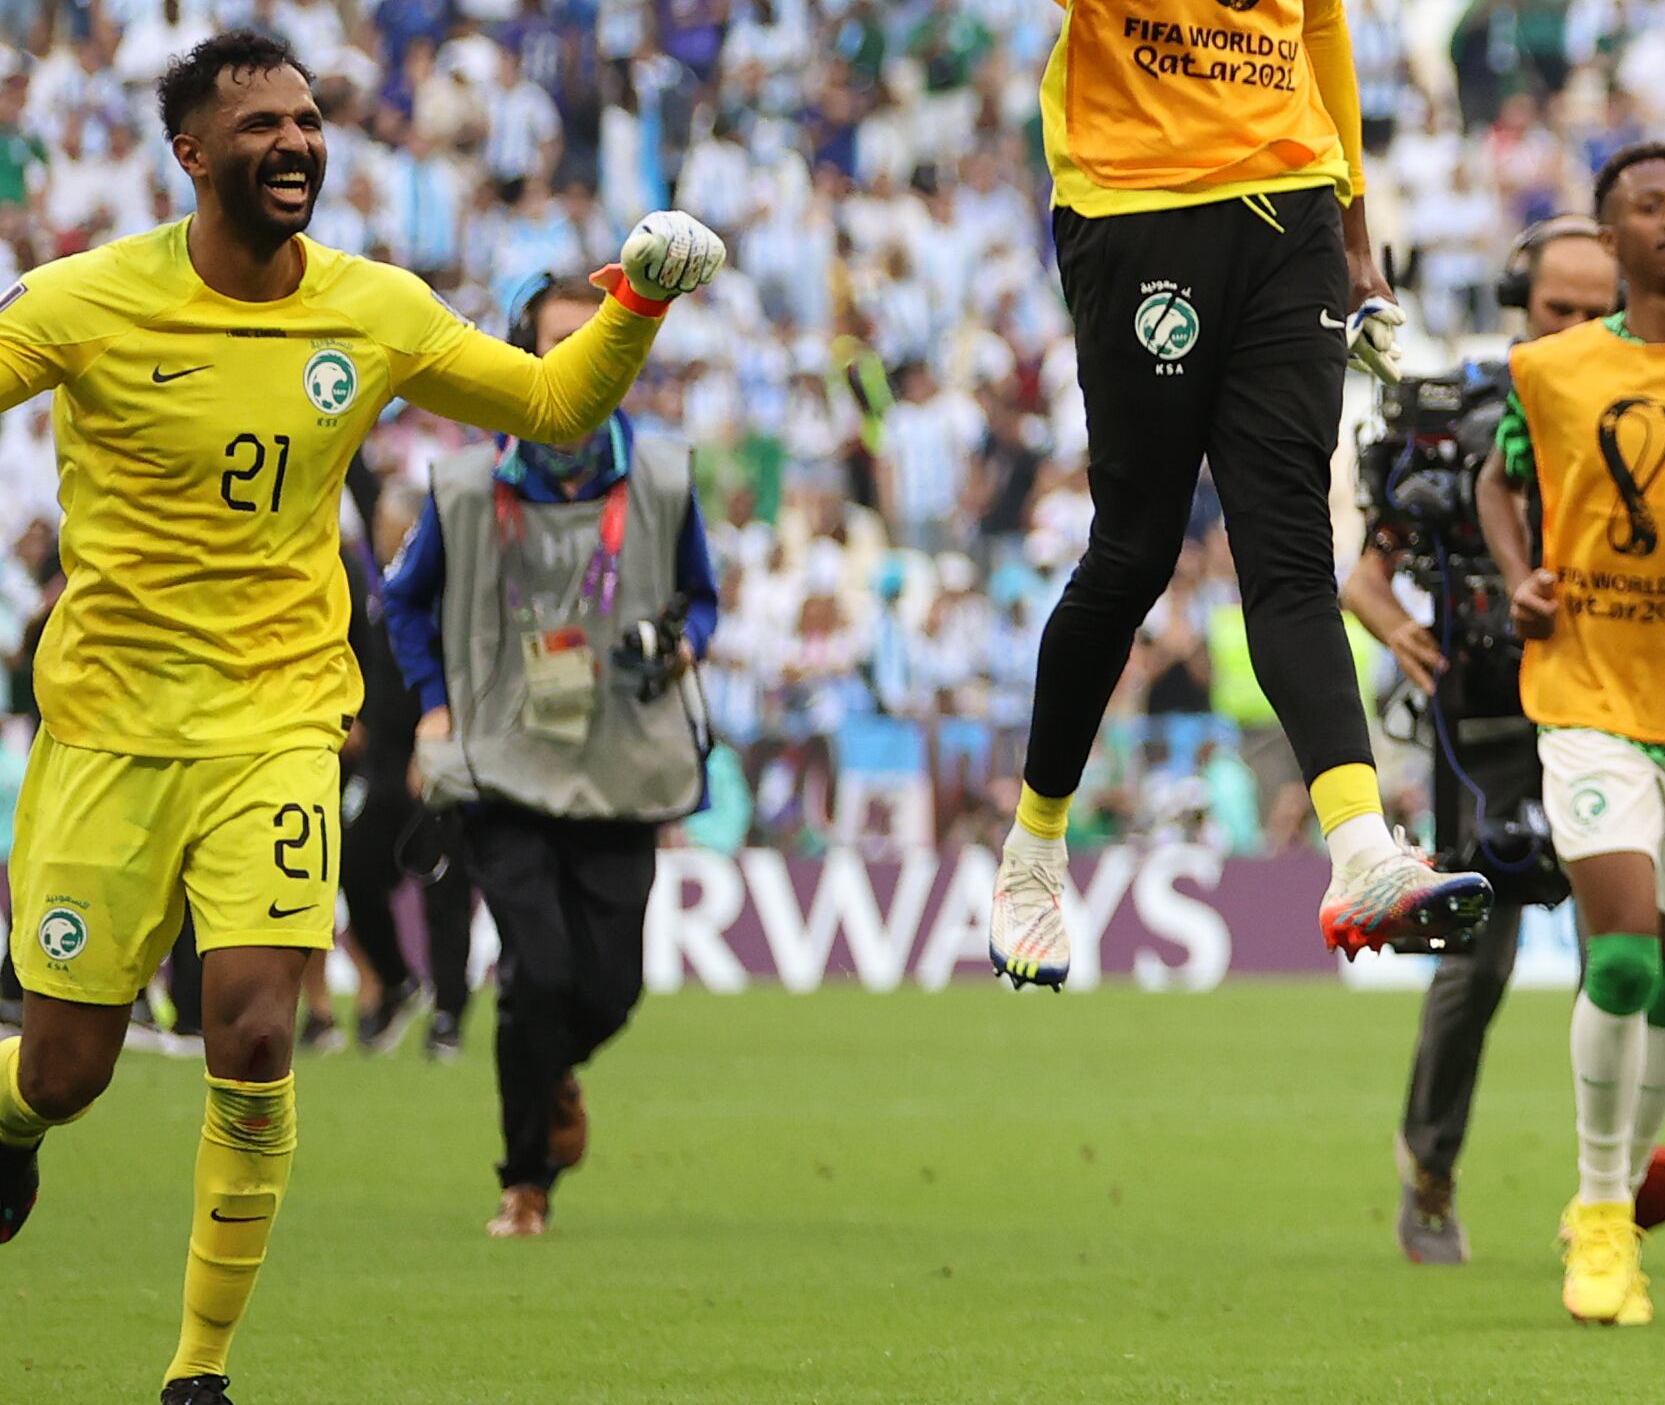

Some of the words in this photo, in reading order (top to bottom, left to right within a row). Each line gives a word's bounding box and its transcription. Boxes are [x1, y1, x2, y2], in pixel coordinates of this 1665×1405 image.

[1124, 17, 1183, 45] FIFA
[1189, 25, 1274, 57] WORLD
[1278, 39, 1299, 62] CU
[1155, 363, 1184, 376] KSA
[220, 432, 291, 513] 21
[273, 803, 329, 882] 21
